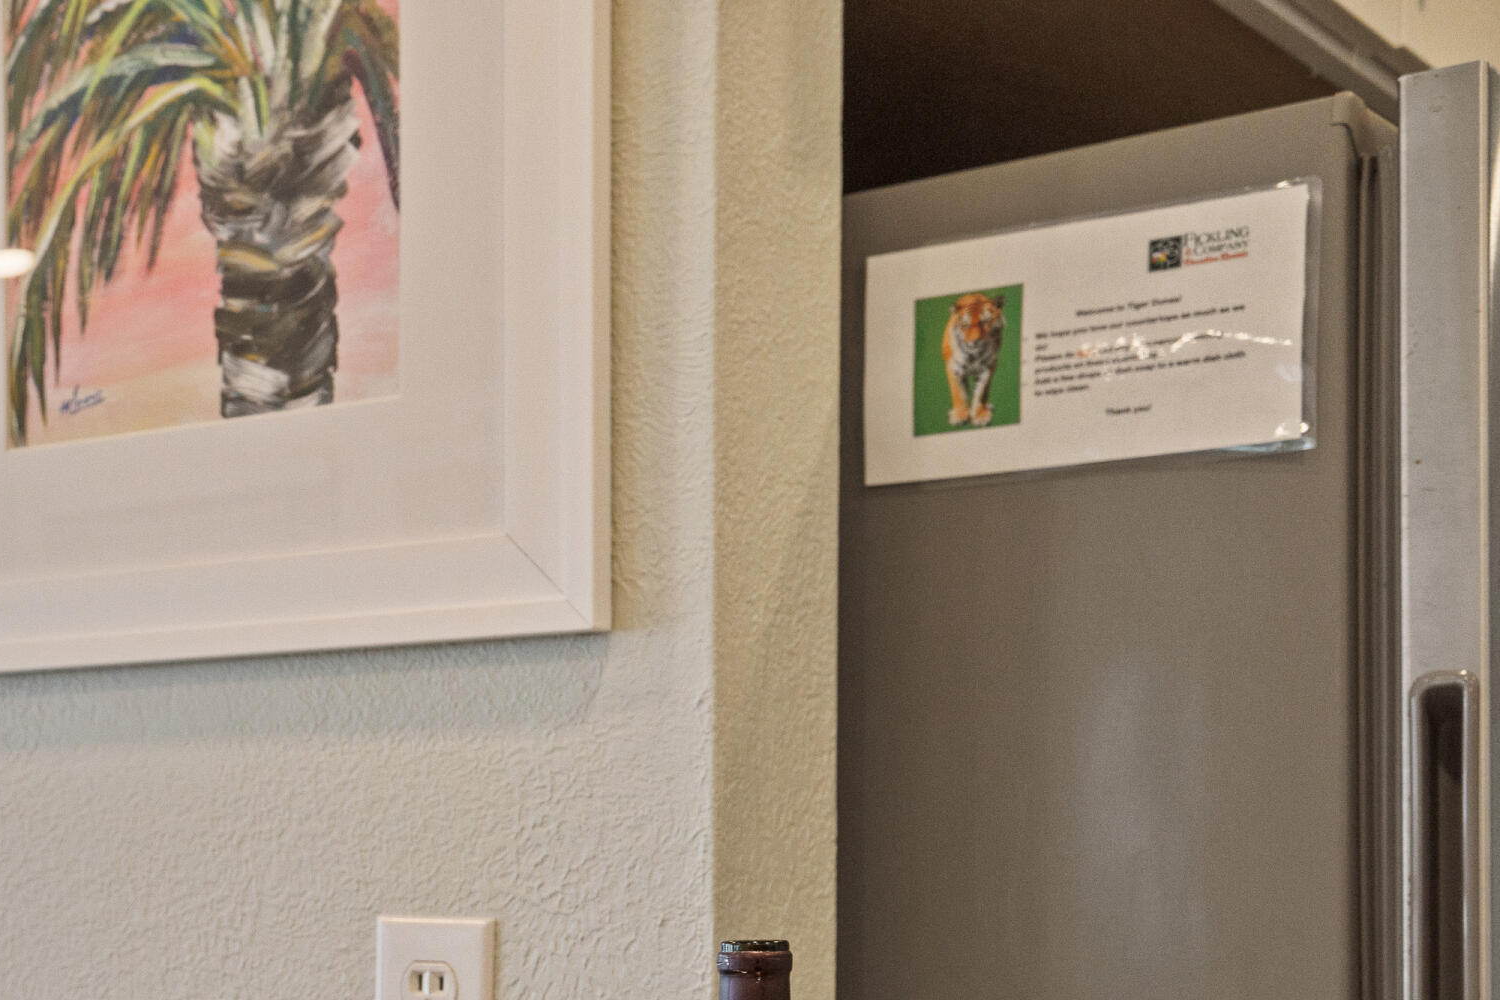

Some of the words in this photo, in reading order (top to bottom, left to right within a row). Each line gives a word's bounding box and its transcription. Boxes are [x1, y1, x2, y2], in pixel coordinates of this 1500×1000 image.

[1182, 225, 1249, 246] FICKLING
[1076, 307, 1115, 317] Welcome
[1127, 301, 1149, 310] Tiger
[1035, 331, 1048, 339] We
[1050, 329, 1071, 338] hope
[1073, 327, 1088, 335] you
[1089, 324, 1107, 332] love
[1193, 307, 1217, 317] much
[1232, 304, 1245, 312] we
[1060, 373, 1074, 381] few
[1045, 387, 1064, 396] wipe
[1105, 406, 1131, 416] Thank
